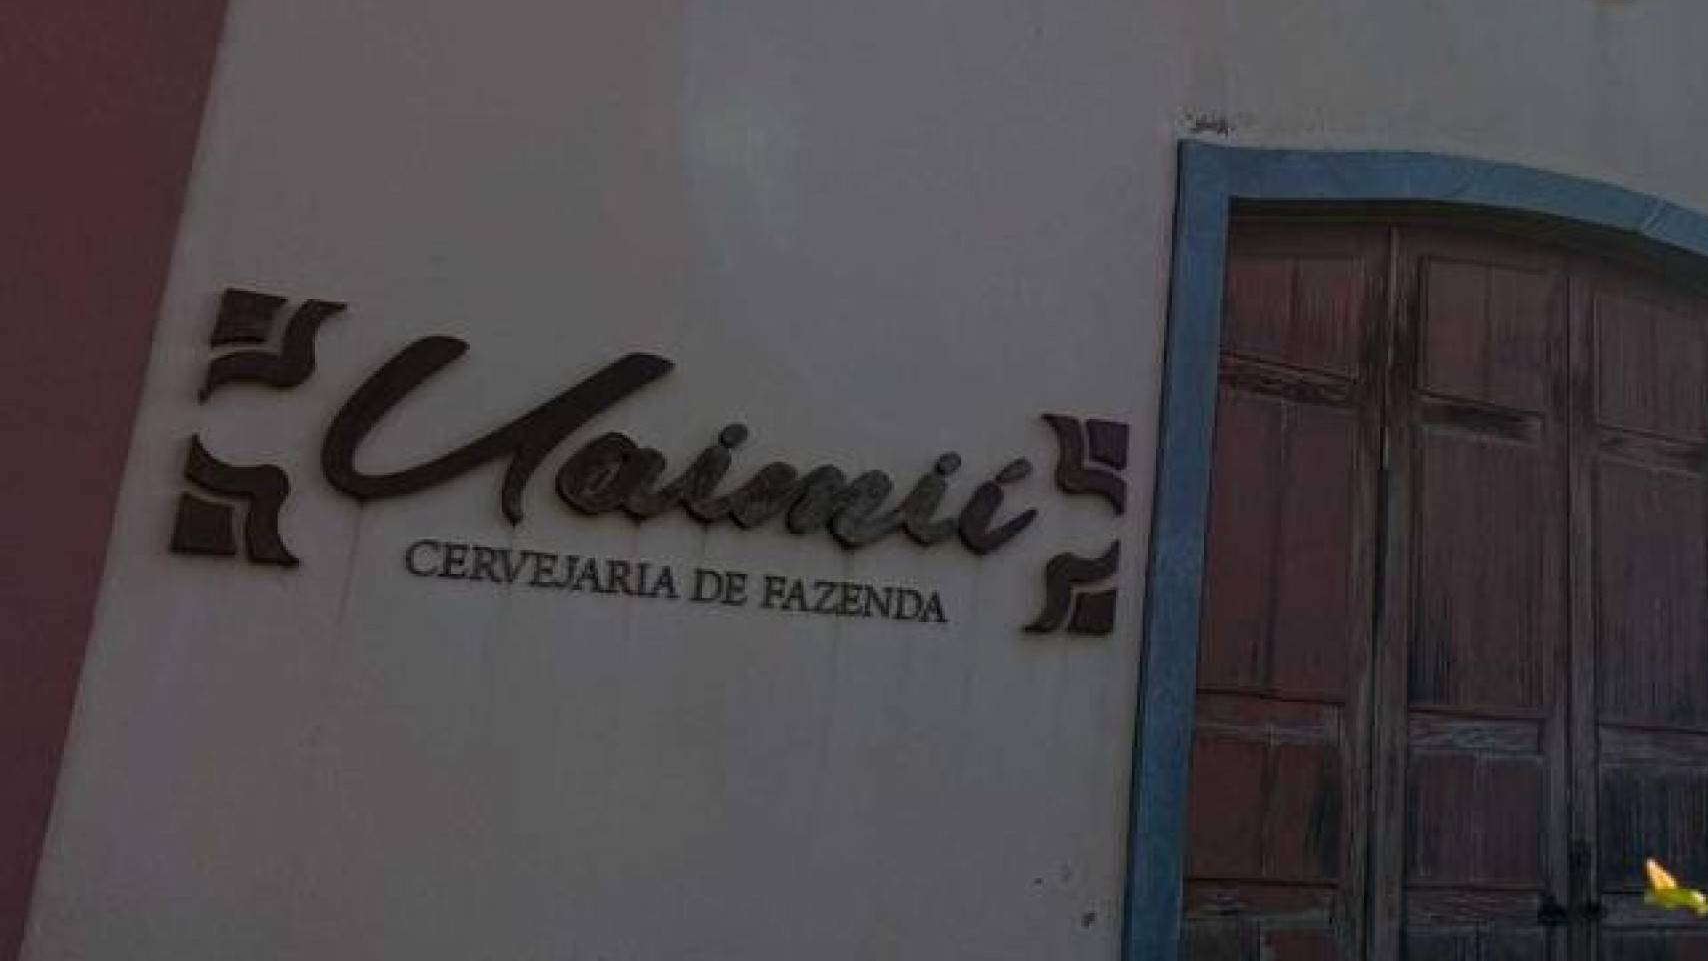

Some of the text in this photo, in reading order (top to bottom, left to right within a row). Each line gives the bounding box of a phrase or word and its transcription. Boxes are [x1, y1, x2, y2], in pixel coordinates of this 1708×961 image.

[404, 539, 948, 623] CERVEJARIA DE FAZENDA
